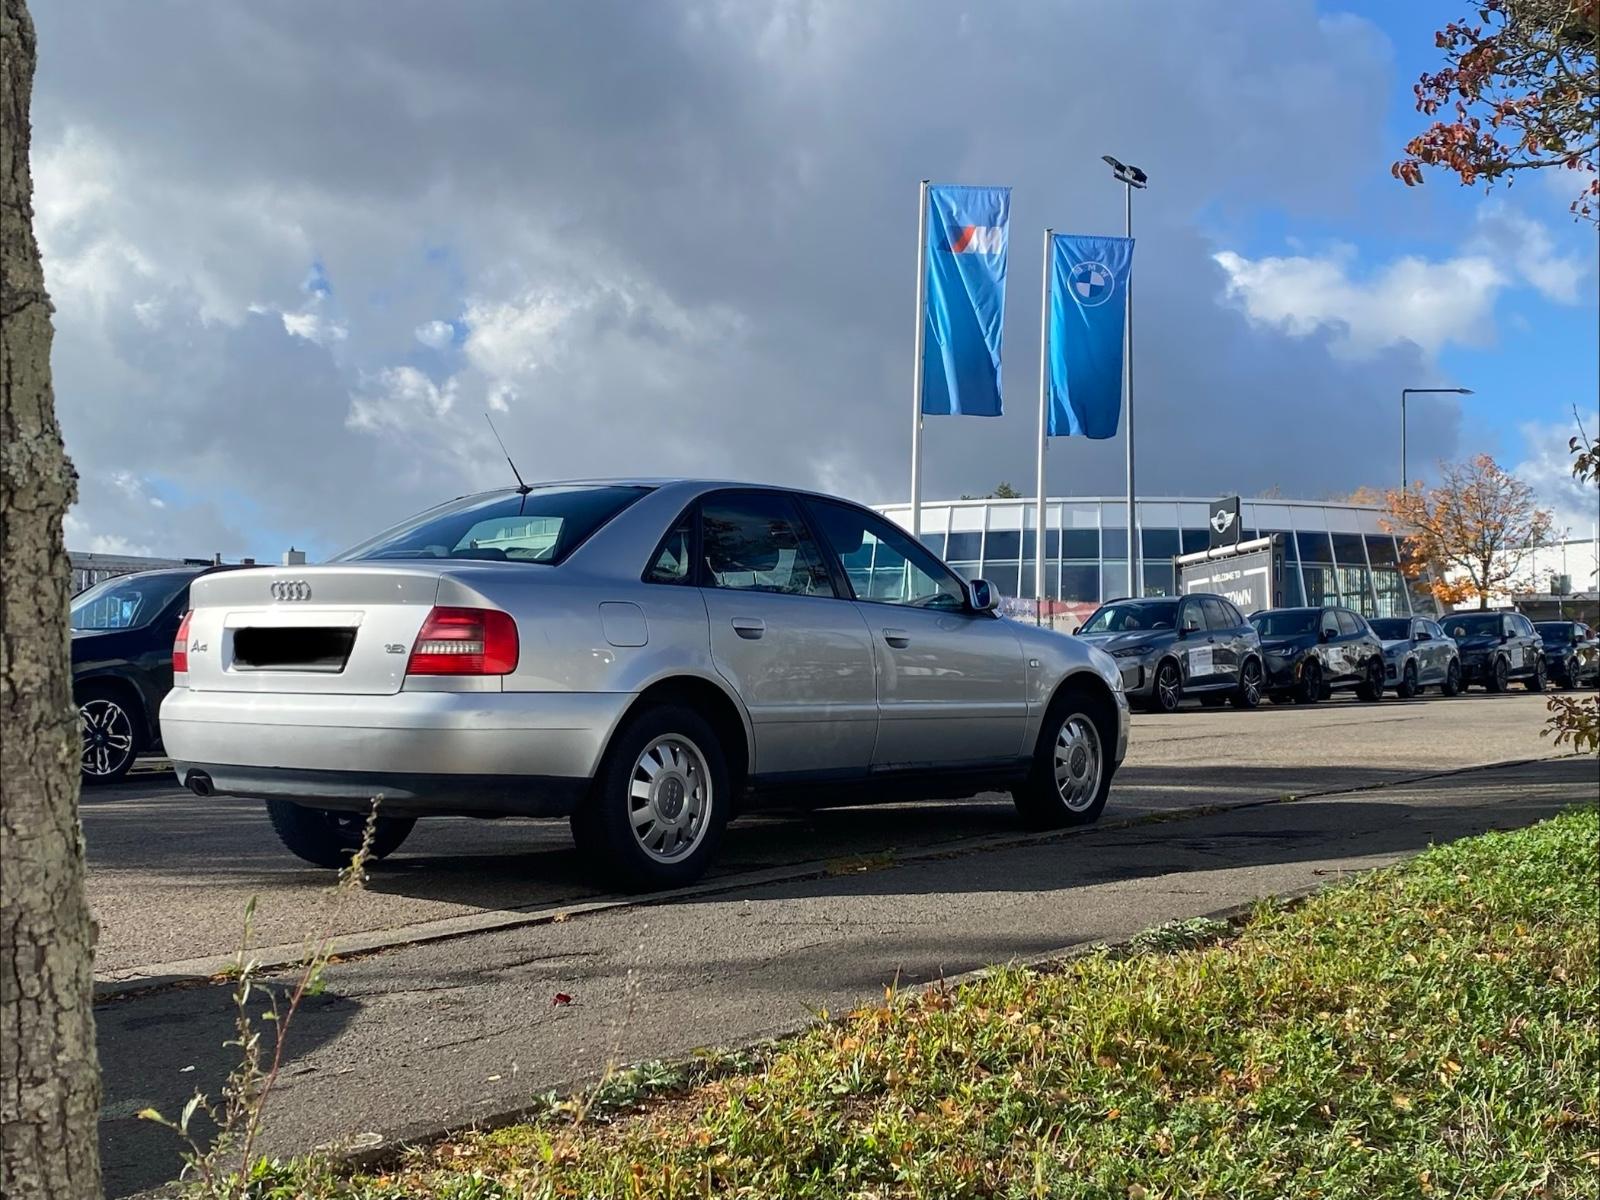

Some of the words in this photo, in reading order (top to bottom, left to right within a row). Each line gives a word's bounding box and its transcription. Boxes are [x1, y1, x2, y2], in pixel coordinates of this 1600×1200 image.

[1073, 263, 1109, 278] BMW
[1212, 571, 1235, 582] WELCOME
[190, 639, 208, 653] A4
